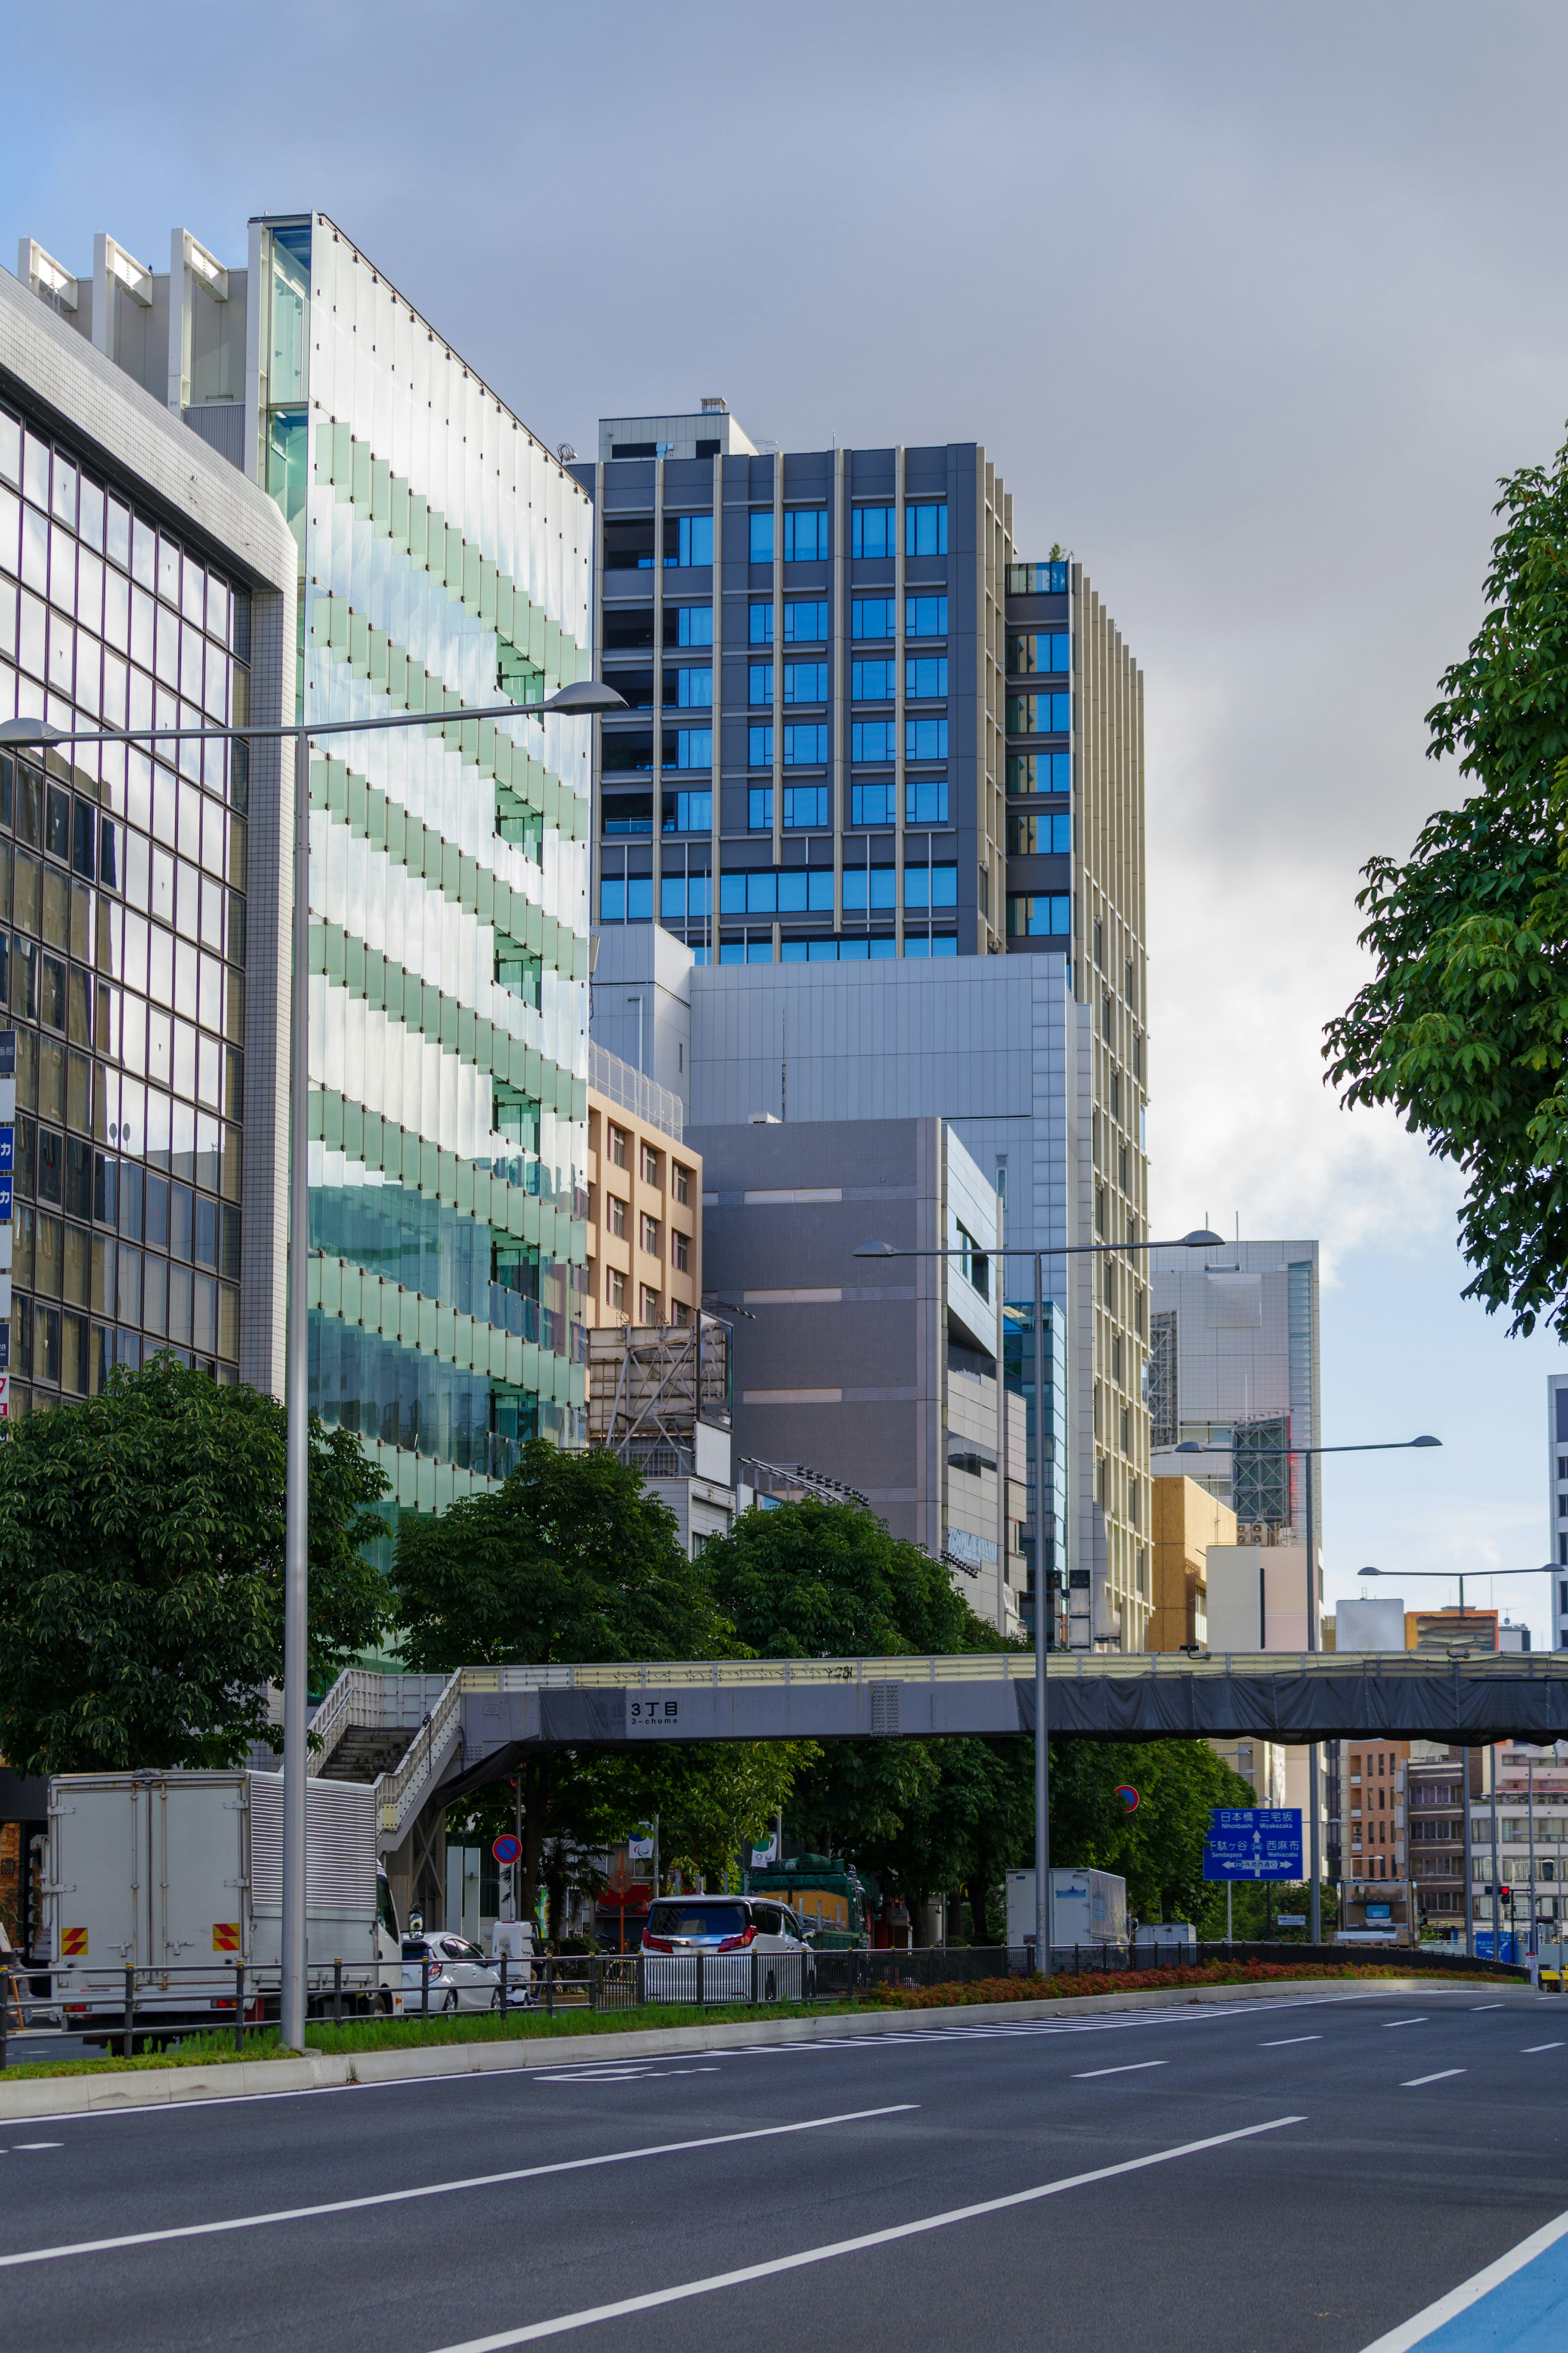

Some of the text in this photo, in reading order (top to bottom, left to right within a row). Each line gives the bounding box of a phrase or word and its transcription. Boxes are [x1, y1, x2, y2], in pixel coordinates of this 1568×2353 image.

[631, 1702, 677, 1716] 3丁目
[1221, 1812, 1292, 1822] 日本橋 三宅坂
[1267, 1840, 1299, 1850] 西麻布
